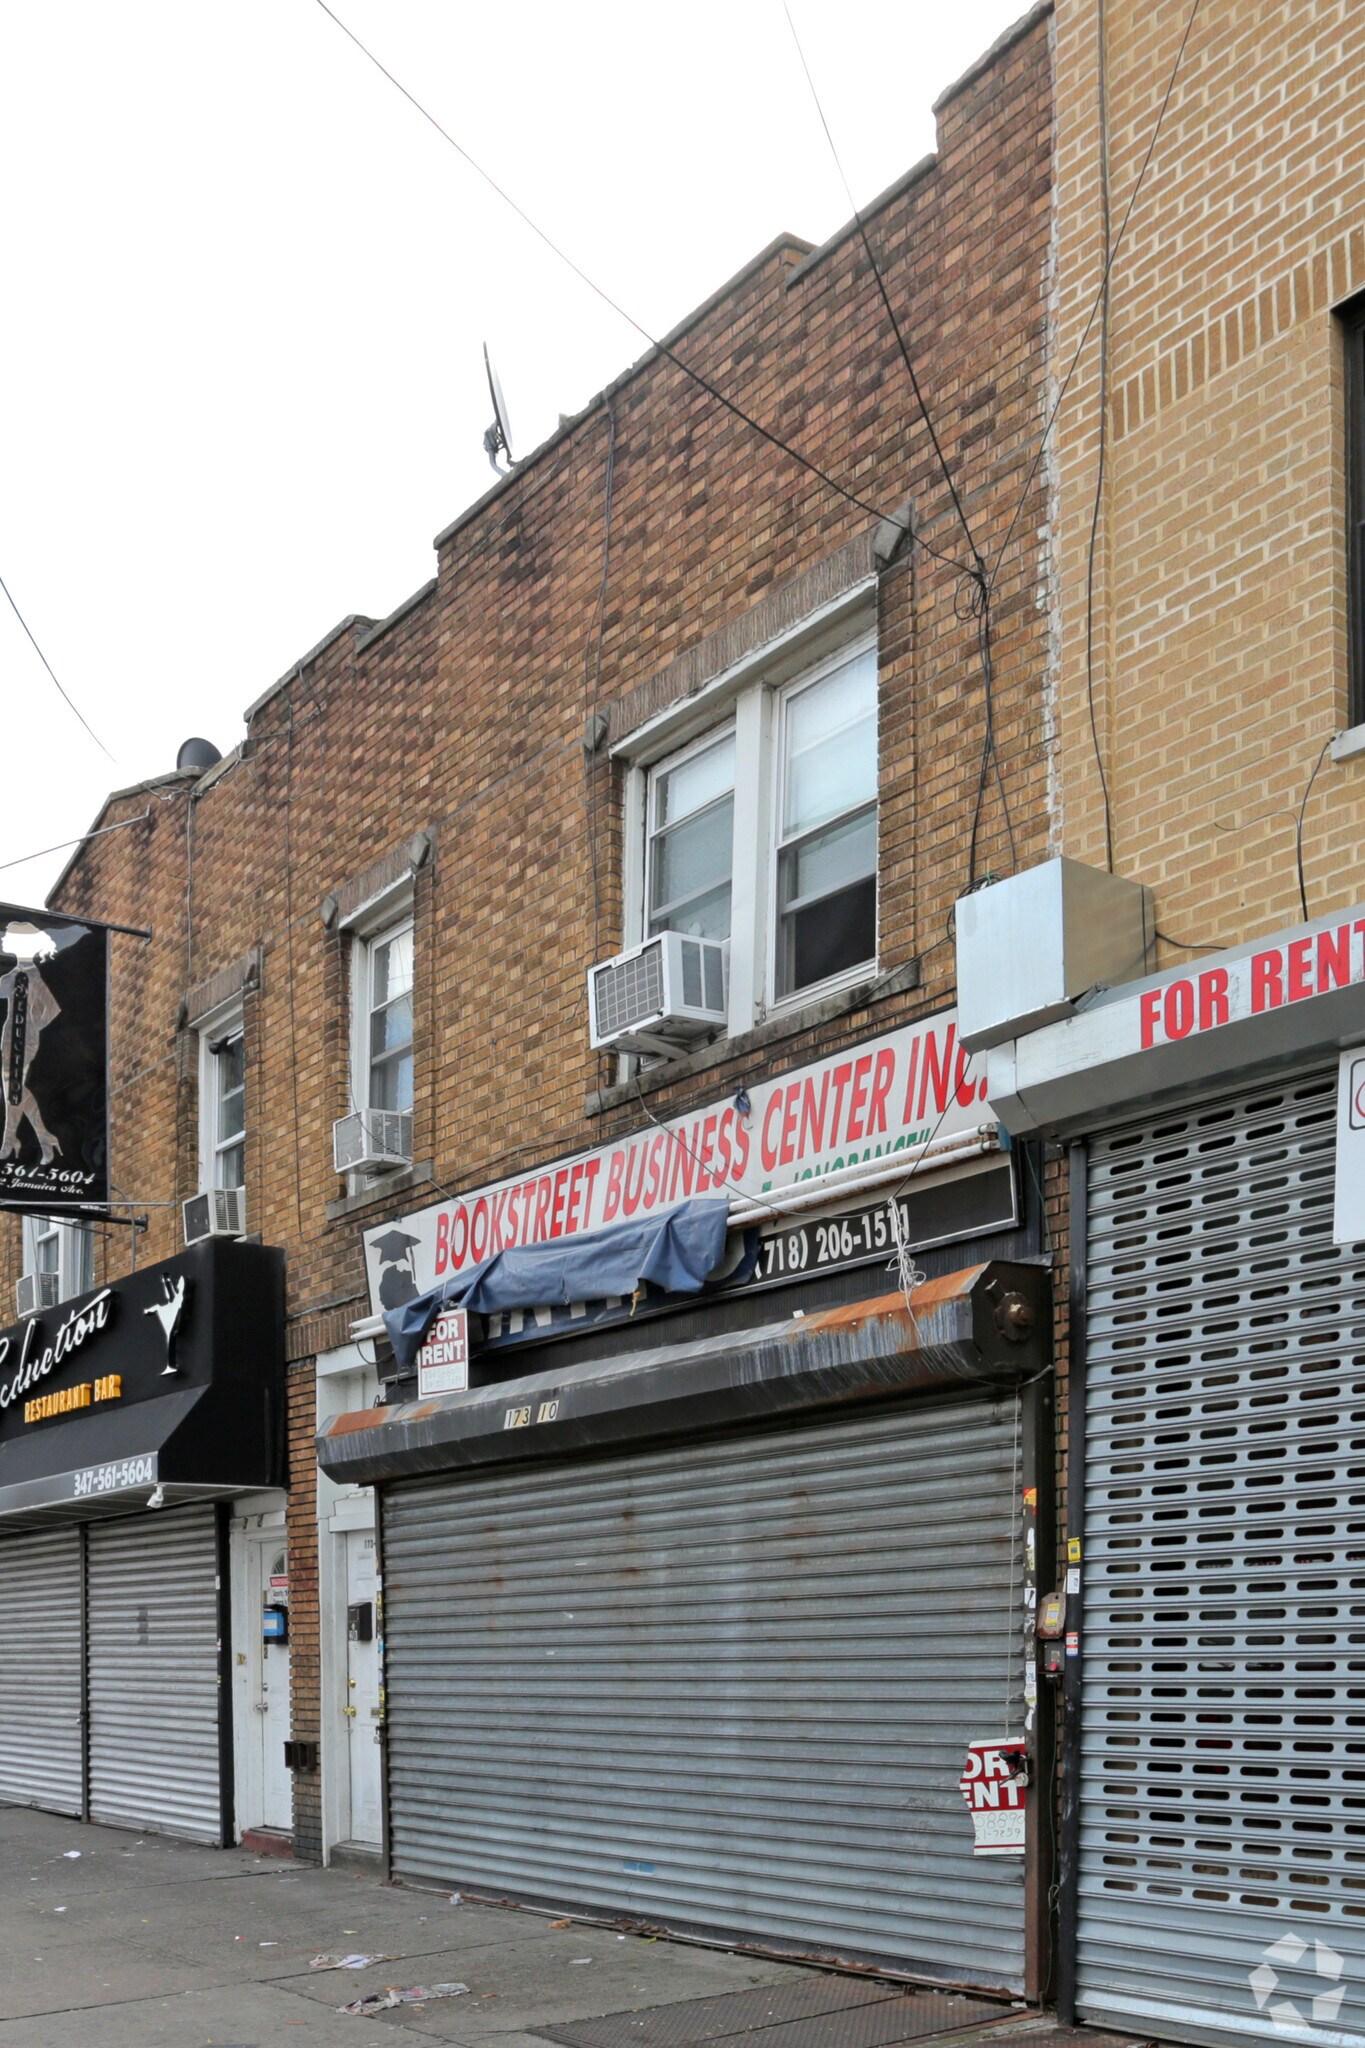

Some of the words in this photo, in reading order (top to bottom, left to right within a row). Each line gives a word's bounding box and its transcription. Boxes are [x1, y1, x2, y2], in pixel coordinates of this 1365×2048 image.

[1140, 968, 1229, 1050] FOR
[435, 1157, 601, 1276] BOOKSTREET
[603, 1106, 750, 1223] BUSINESS
[761, 1047, 896, 1173] CENTER
[903, 1022, 988, 1126] INC.
[1, 1162, 96, 1185] 561-5604
[7, 1178, 57, 1192] Jamaica
[815, 1204, 910, 1263] 206-1511
[427, 1318, 459, 1343] FOR
[421, 1339, 465, 1366] RENT
[24, 1384, 91, 1423] RESTAURANT
[94, 1374, 121, 1402] BAR
[507, 1407, 530, 1428] 173
[540, 1402, 557, 1421] 10
[74, 1457, 153, 1496] 347-561-5604
